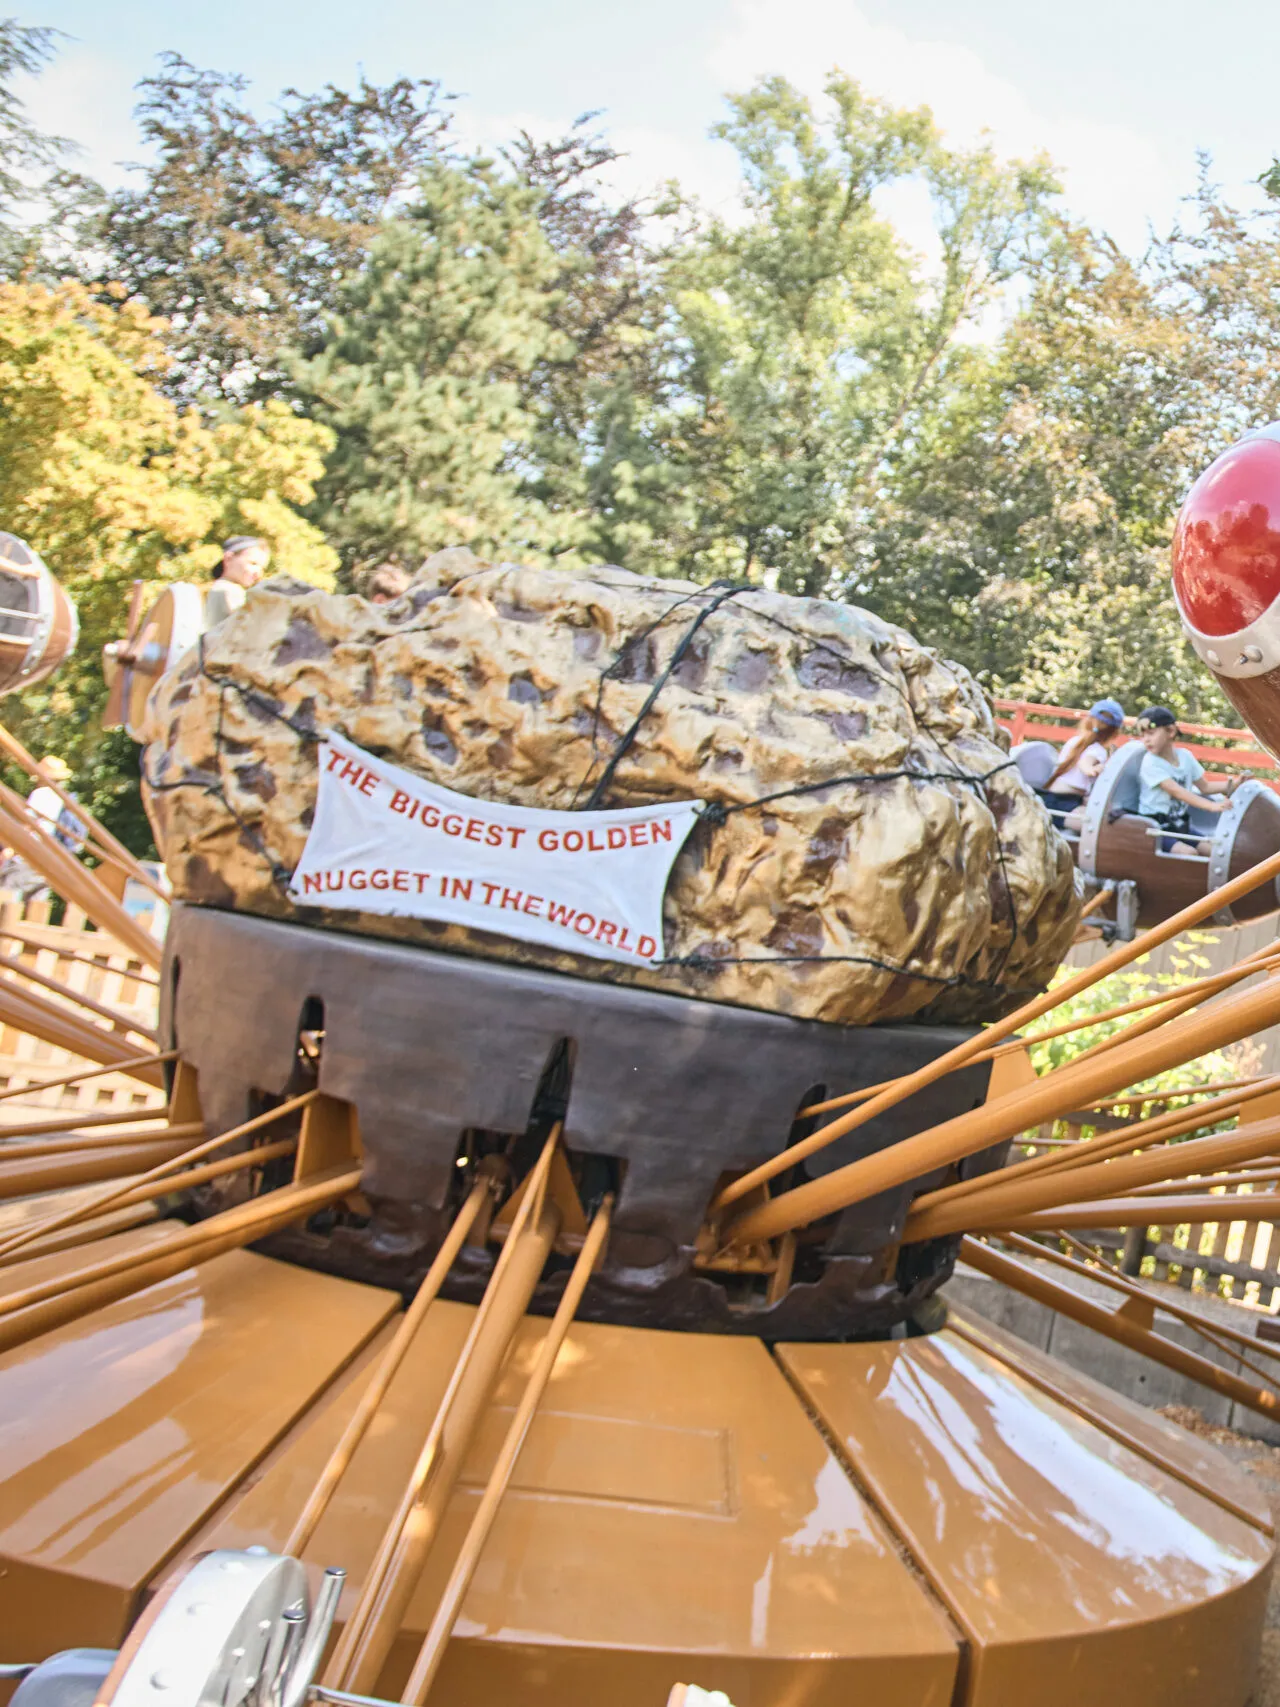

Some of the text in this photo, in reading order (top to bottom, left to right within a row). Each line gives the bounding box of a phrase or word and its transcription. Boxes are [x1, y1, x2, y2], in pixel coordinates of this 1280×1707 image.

[325, 749, 673, 852] THE BIGGEST GOLDEN
[302, 869, 658, 959] NUGGET IN THE WORLD
